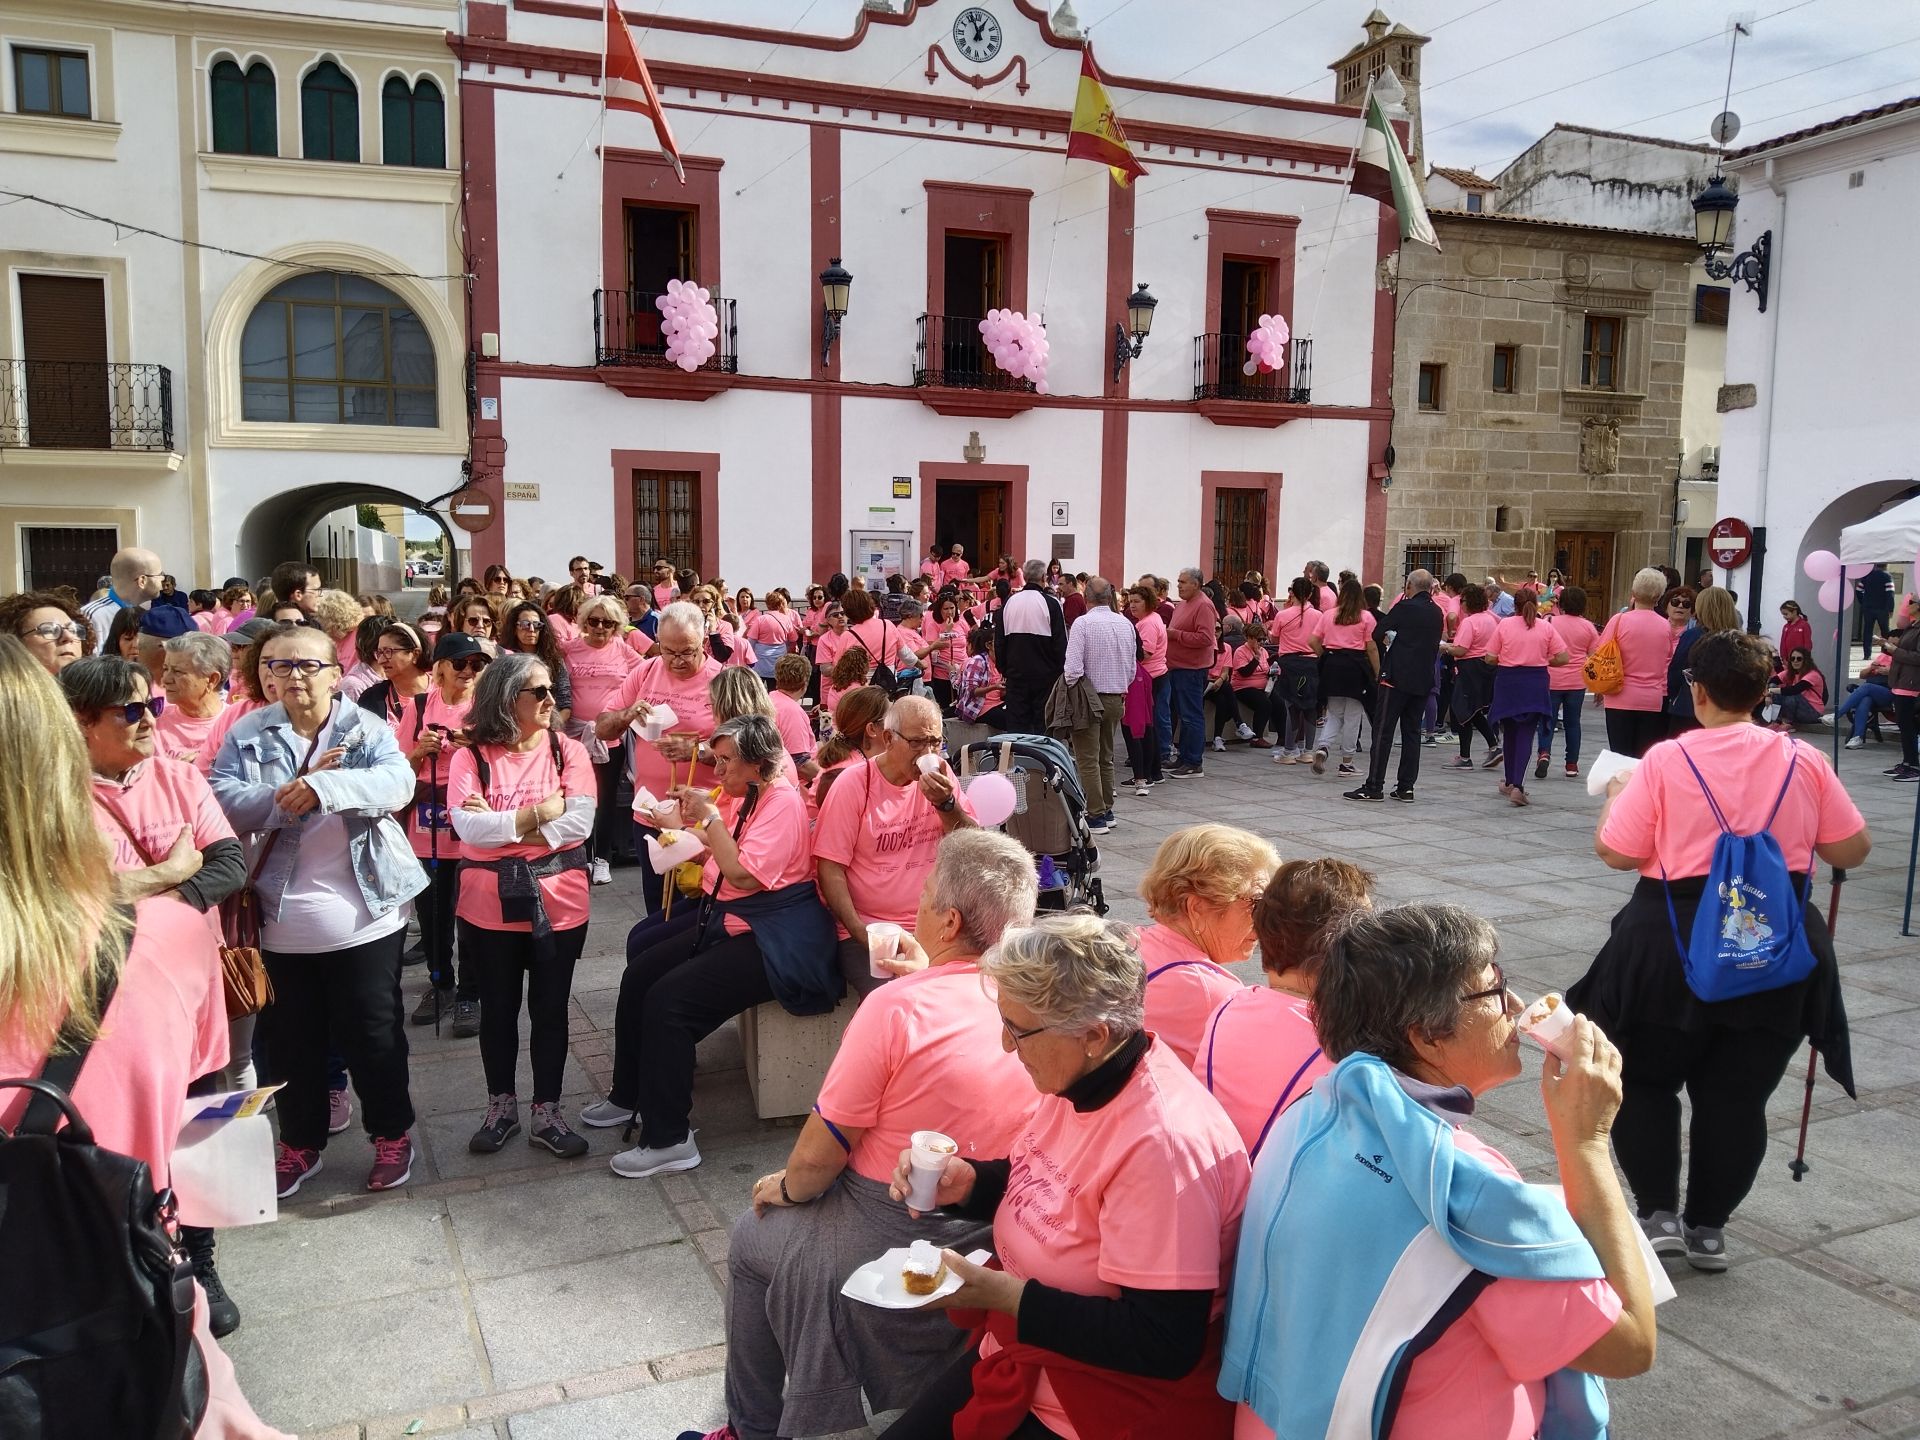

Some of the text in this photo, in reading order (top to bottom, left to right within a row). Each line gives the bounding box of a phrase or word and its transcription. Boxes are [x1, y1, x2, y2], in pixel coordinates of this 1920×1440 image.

[506, 489, 538, 499] ESPAÑA
[876, 827, 908, 852] 100%
[1354, 1153, 1393, 1184] Boomerang
